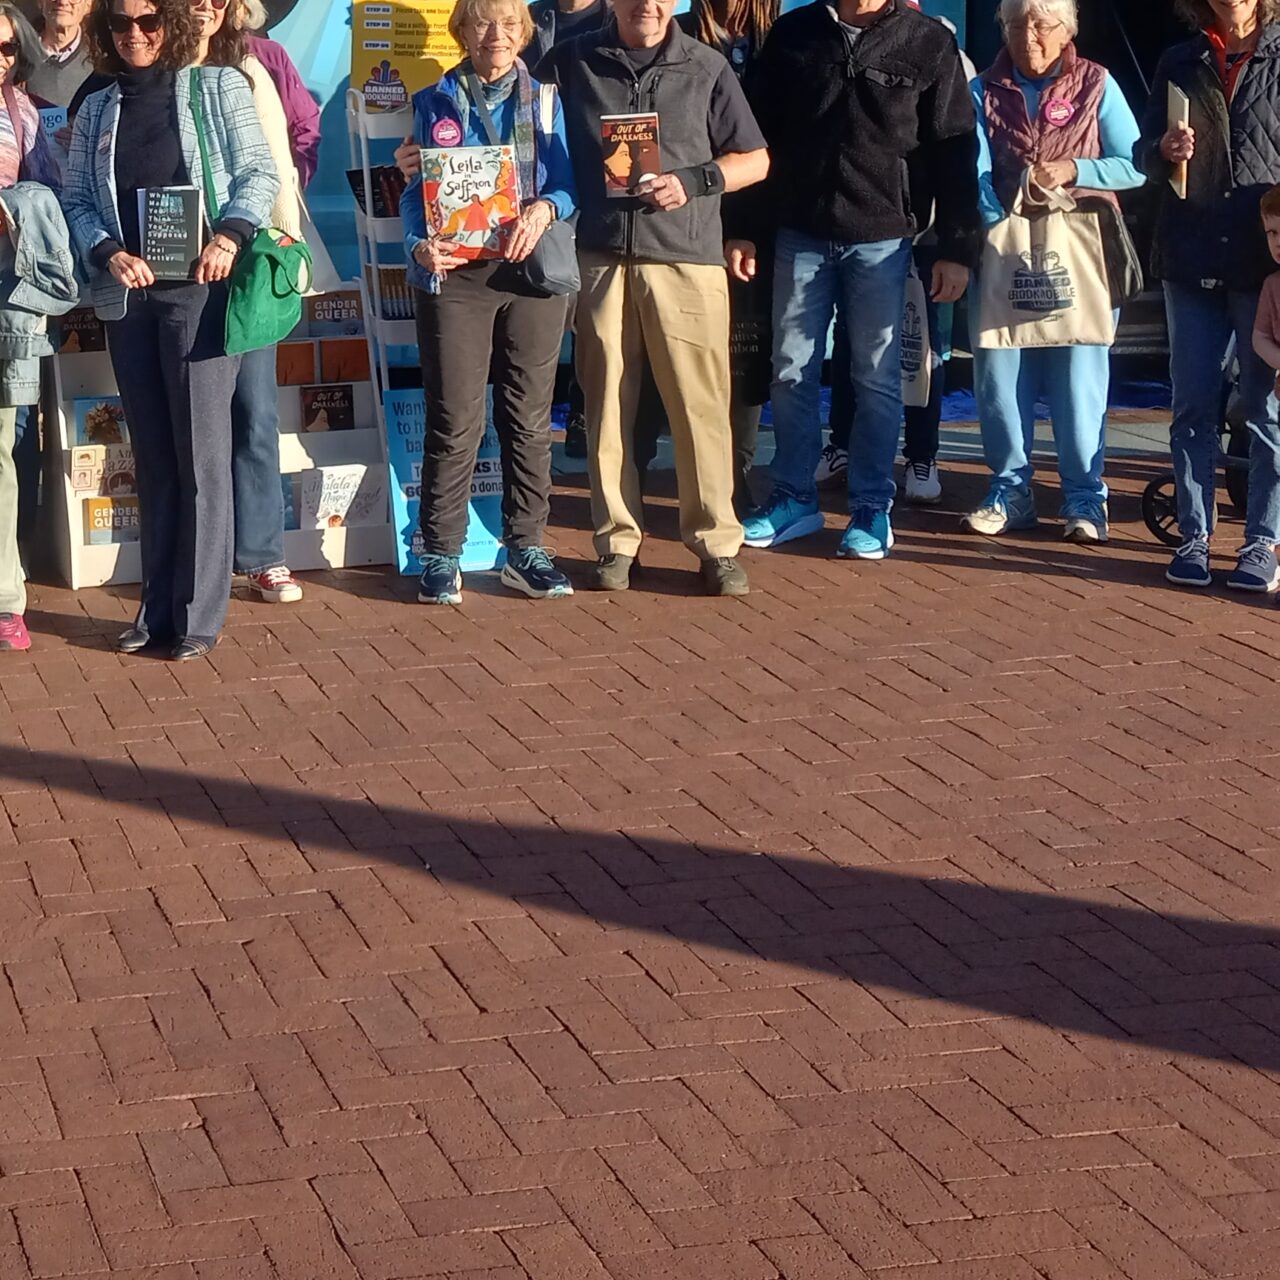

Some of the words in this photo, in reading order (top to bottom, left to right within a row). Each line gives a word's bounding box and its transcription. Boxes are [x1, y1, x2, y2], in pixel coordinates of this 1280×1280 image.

[617, 124, 634, 134] OUT
[635, 123, 647, 132] OF
[610, 132, 653, 142] DARKNESS
[449, 155, 483, 175] Leila
[444, 179, 491, 203] Saffron
[314, 300, 358, 310] GENDER
[315, 309, 358, 320] QUEER
[397, 420, 410, 435] to
[479, 481, 503, 493] dona
[94, 506, 139, 517] GENDER
[94, 516, 139, 528] QUEER
